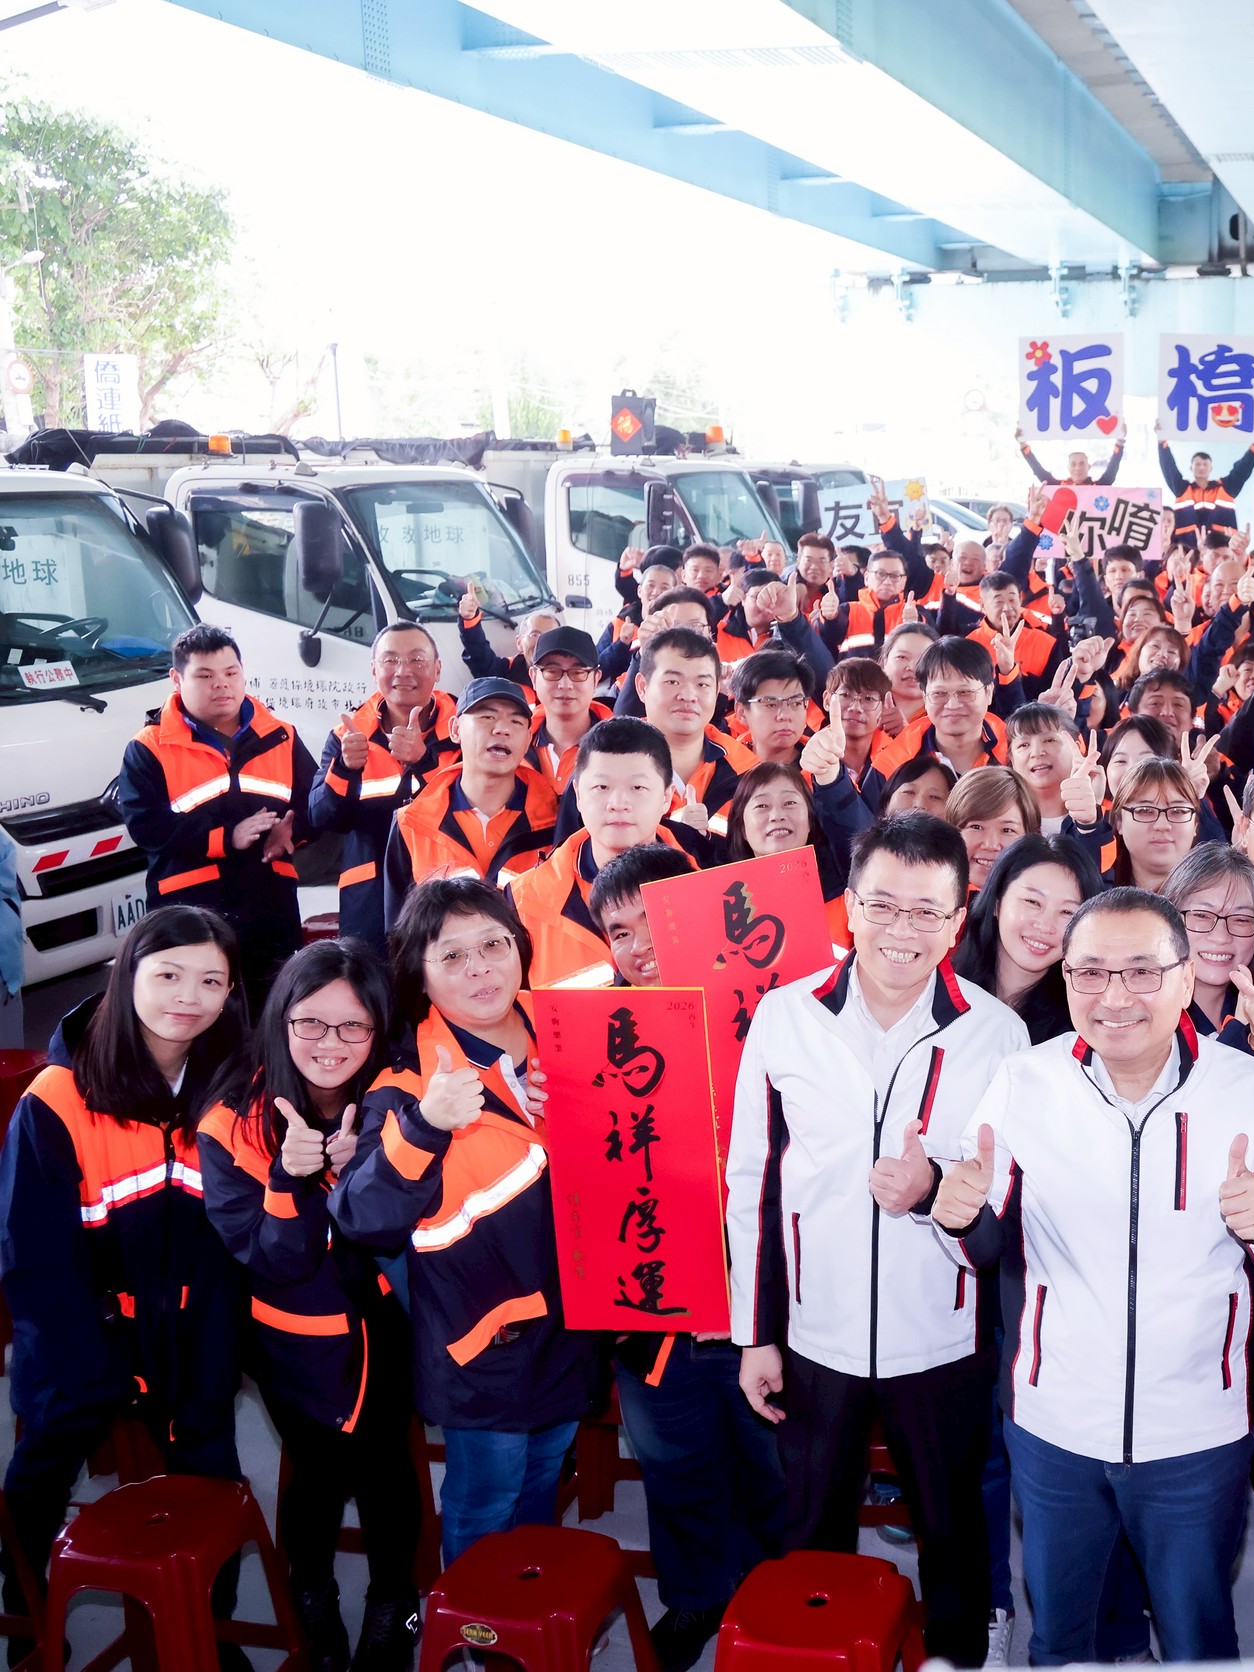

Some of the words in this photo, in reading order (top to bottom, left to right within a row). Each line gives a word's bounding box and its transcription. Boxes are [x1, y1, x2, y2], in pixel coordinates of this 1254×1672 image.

[1025, 343, 1113, 432] 板
[1, 558, 59, 586] 地球
[24, 666, 74, 686] 執行公務中
[0, 791, 51, 814] HINO
[666, 1001, 696, 1011] 2026
[591, 1006, 692, 1317] 馬祥厚運
